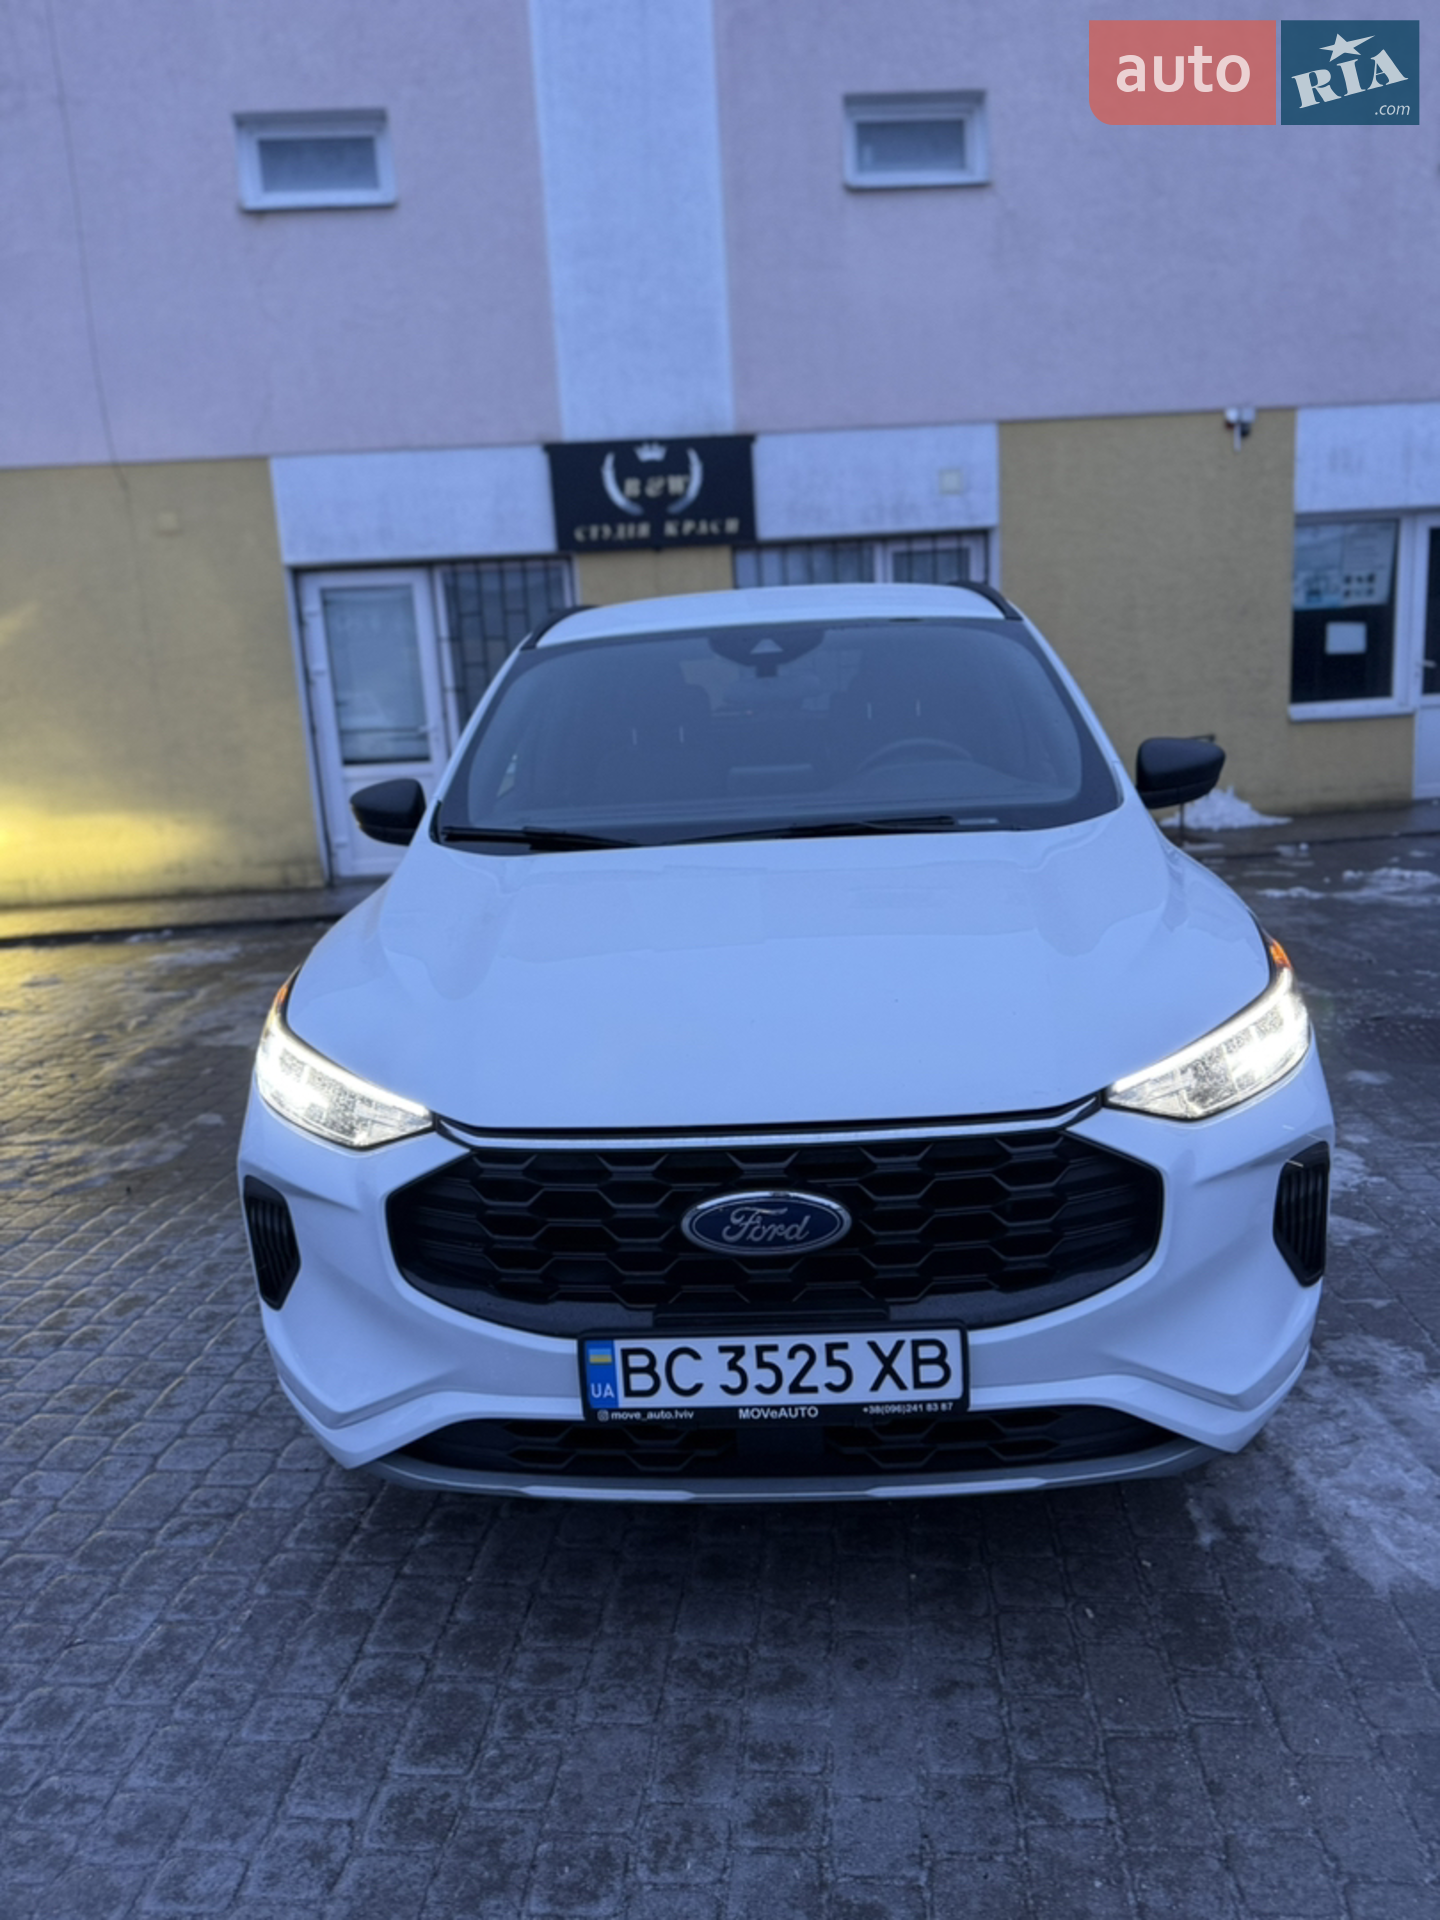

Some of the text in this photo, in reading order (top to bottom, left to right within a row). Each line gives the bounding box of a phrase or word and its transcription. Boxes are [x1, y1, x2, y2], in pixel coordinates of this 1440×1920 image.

[664, 517, 740, 537] КРАСИ
[722, 1207, 811, 1242] Ford
[620, 1338, 952, 1398] BC 3525 XB
[591, 1382, 615, 1398] UA
[611, 1409, 694, 1421] move_auto.lviv
[738, 1406, 819, 1420] MOVeAUTO
